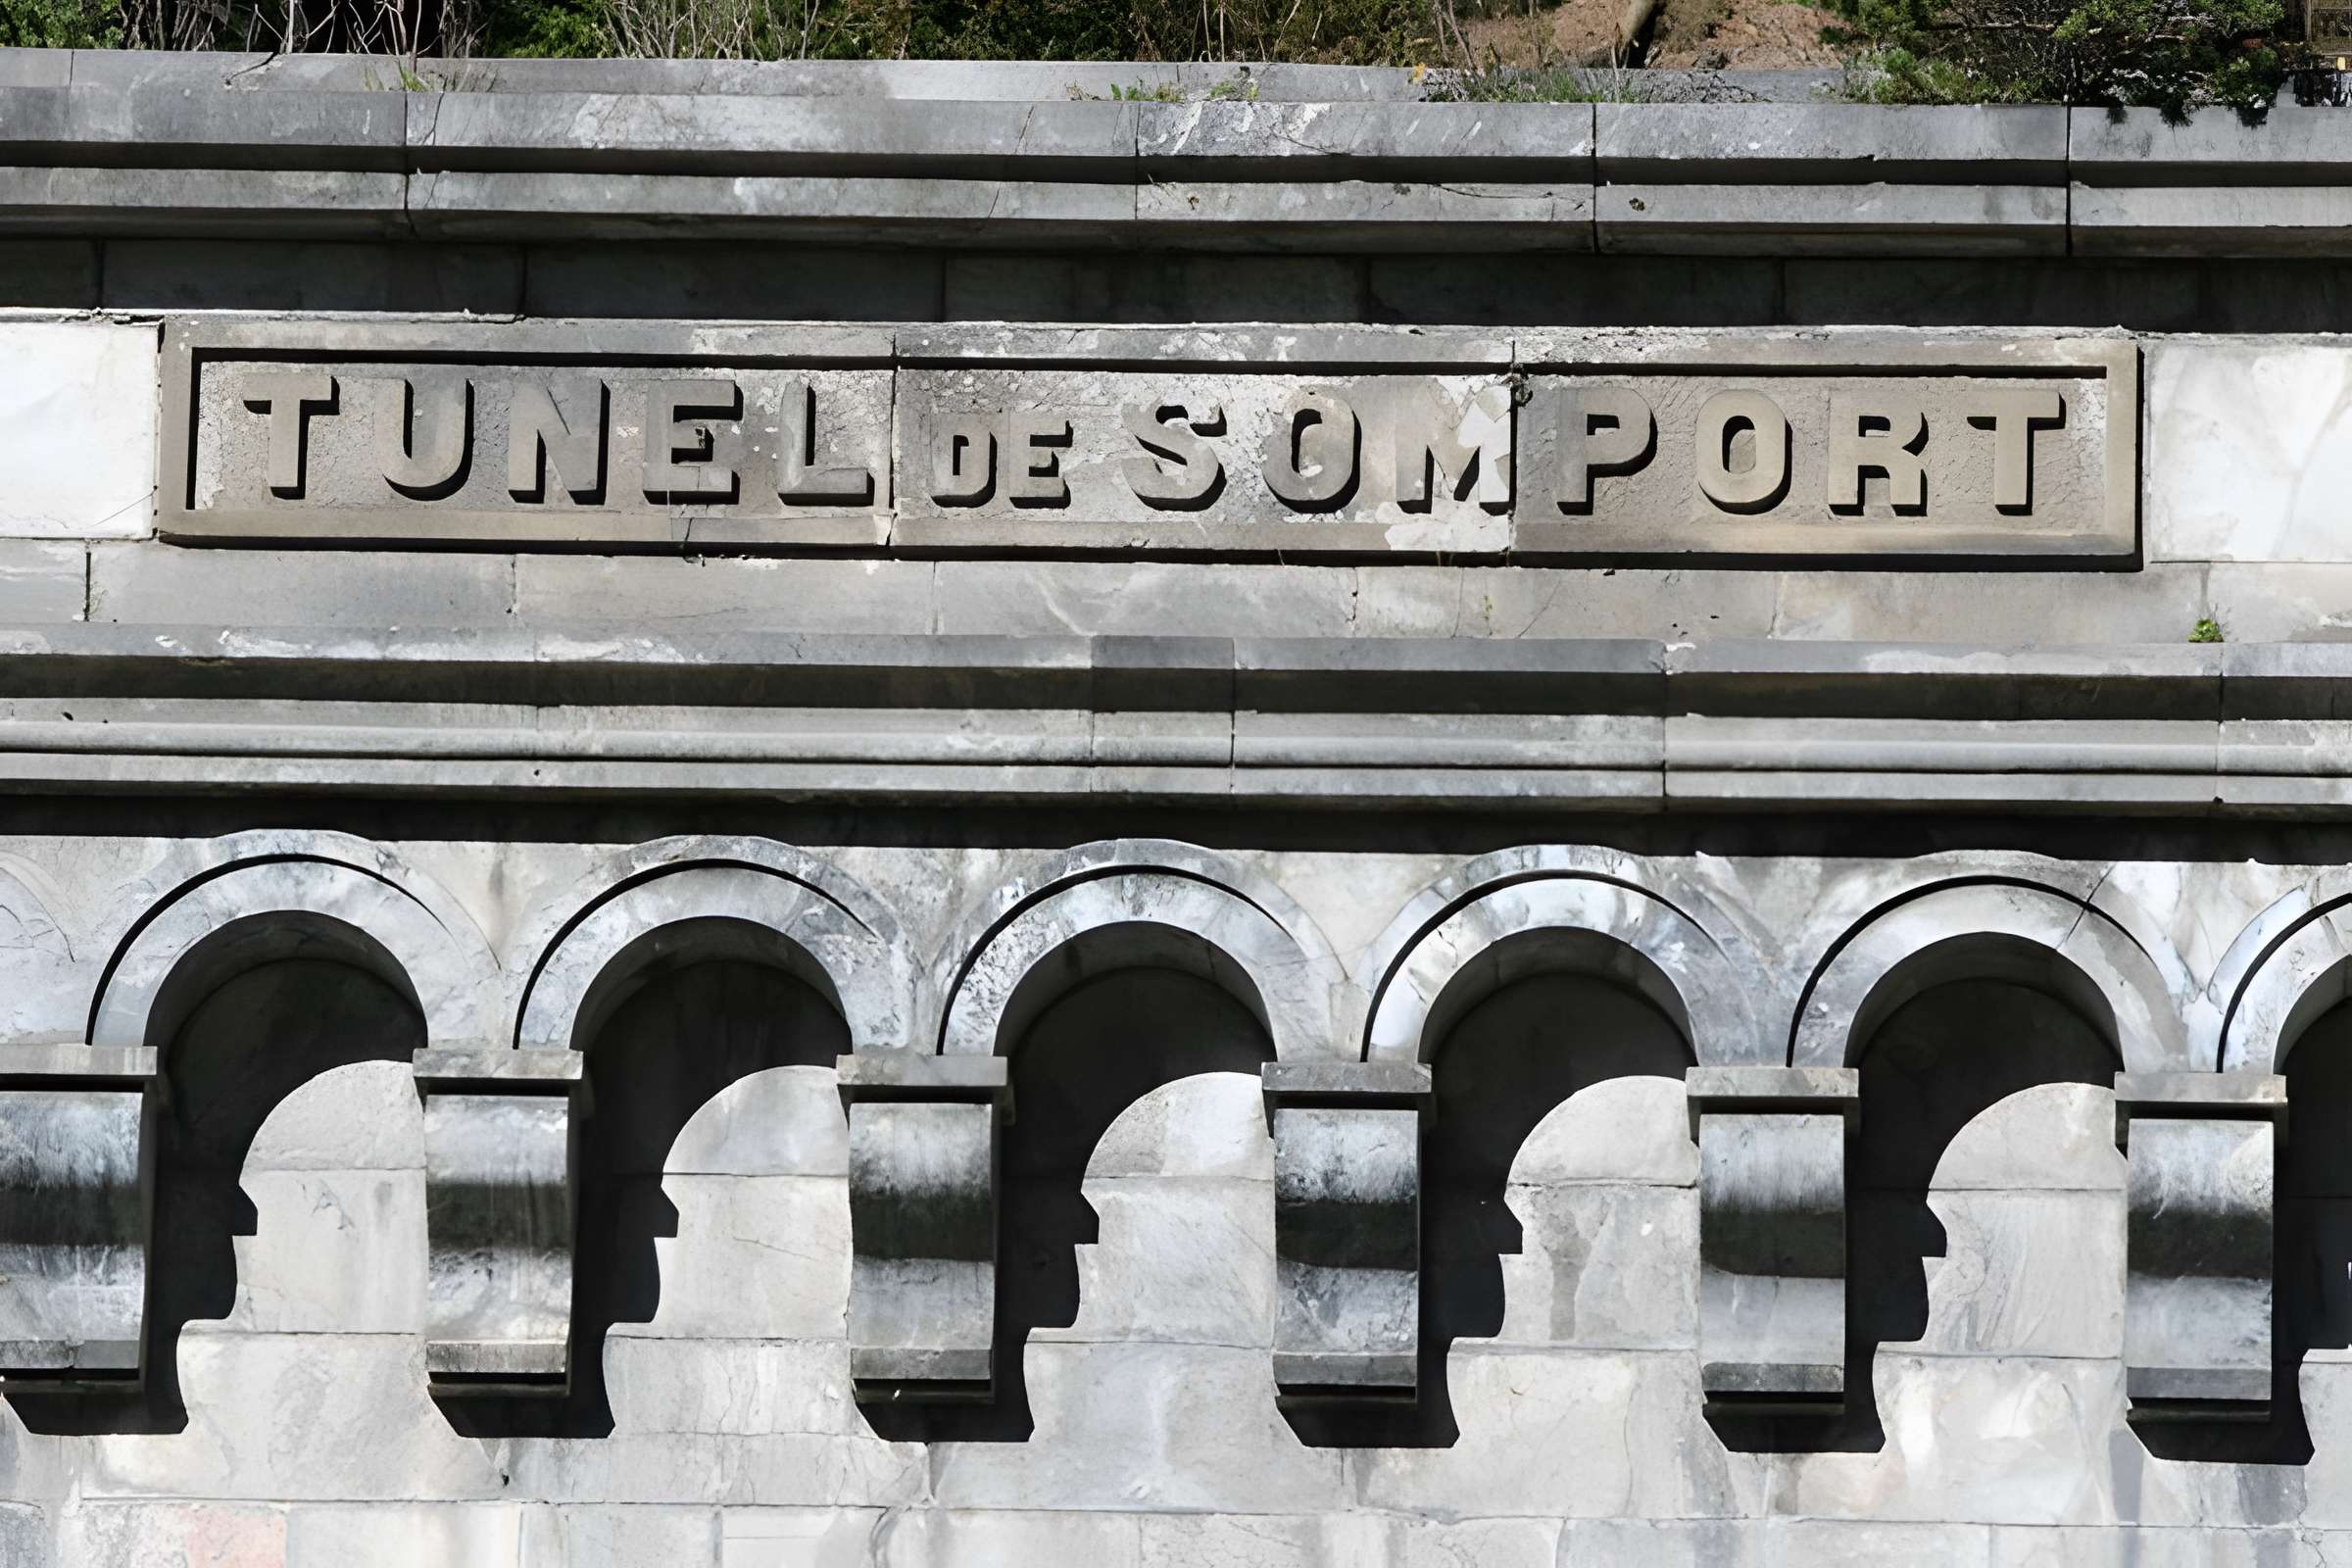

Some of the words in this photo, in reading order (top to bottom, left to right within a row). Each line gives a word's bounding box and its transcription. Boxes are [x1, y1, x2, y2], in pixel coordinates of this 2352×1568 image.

[242, 373, 874, 508] TUNEL
[930, 411, 1074, 509] DE
[1120, 387, 2066, 516] SOMPORT
